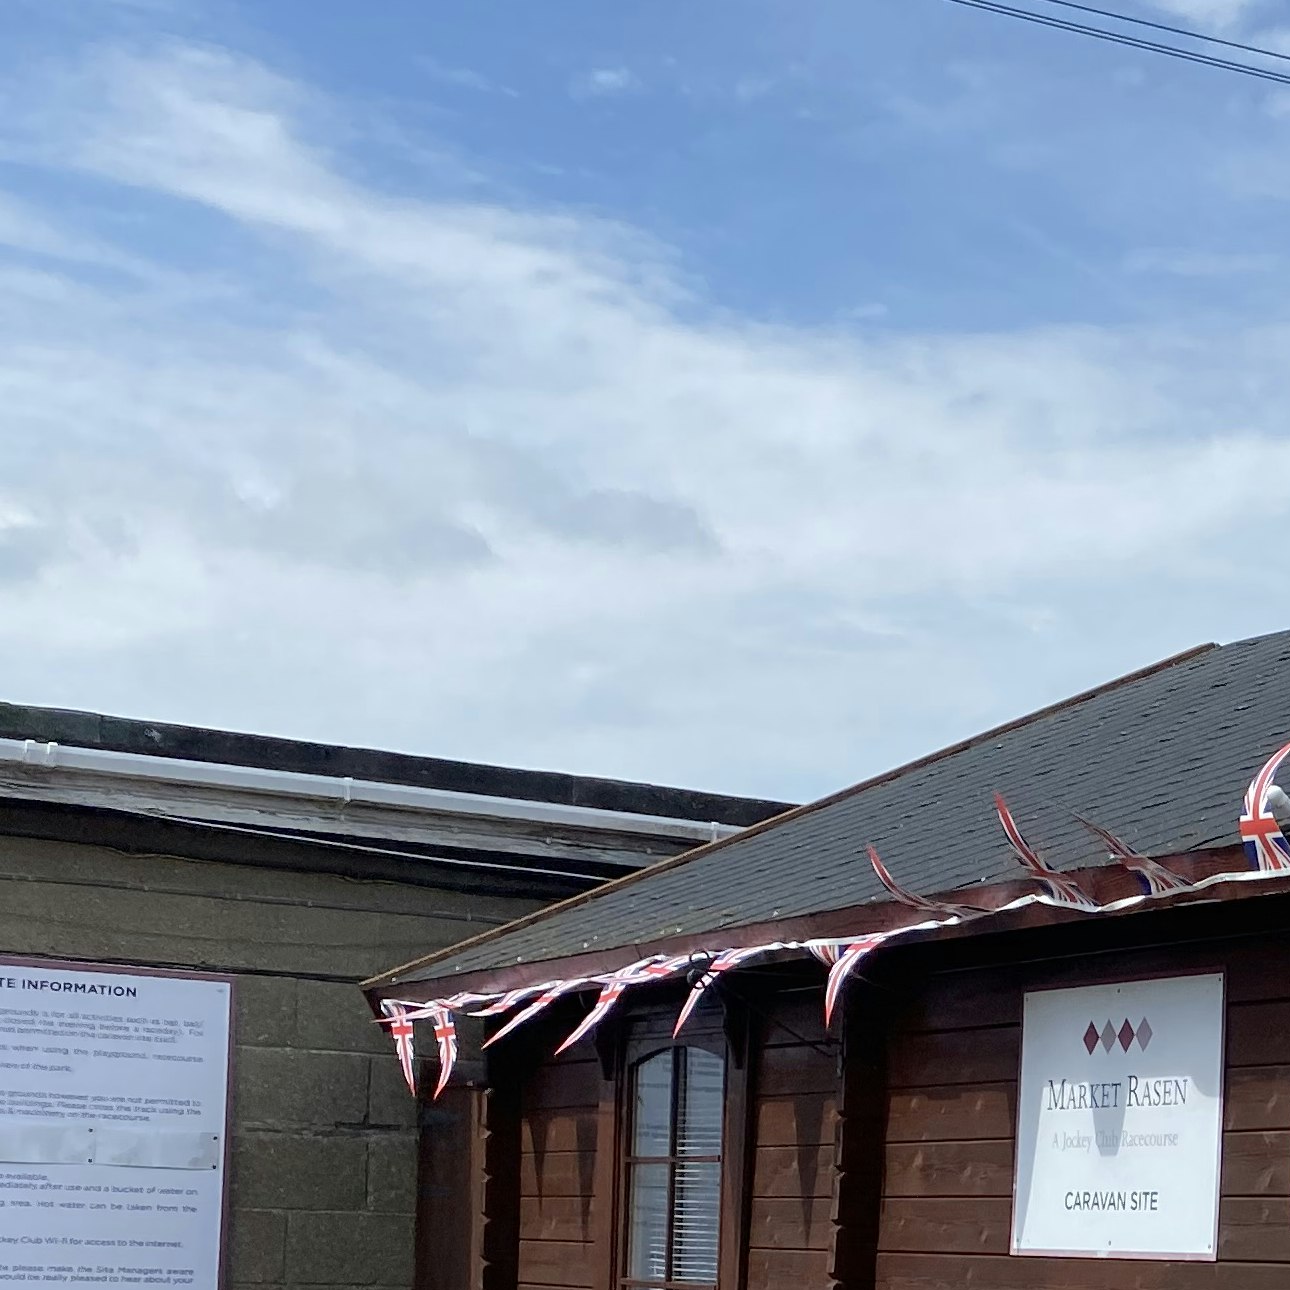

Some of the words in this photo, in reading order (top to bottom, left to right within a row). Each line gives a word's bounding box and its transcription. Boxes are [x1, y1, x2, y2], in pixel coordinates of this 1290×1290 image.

[22, 979, 137, 998] INFORMATION
[1052, 1132, 1060, 1148] A
[1062, 1130, 1092, 1153] Jockey
[1096, 1129, 1119, 1147] Club
[1122, 1130, 1178, 1148] Racecourse
[1064, 1191, 1126, 1211] CARAVAN
[1130, 1191, 1158, 1211] SITE
[21, 1236, 43, 1244] Club
